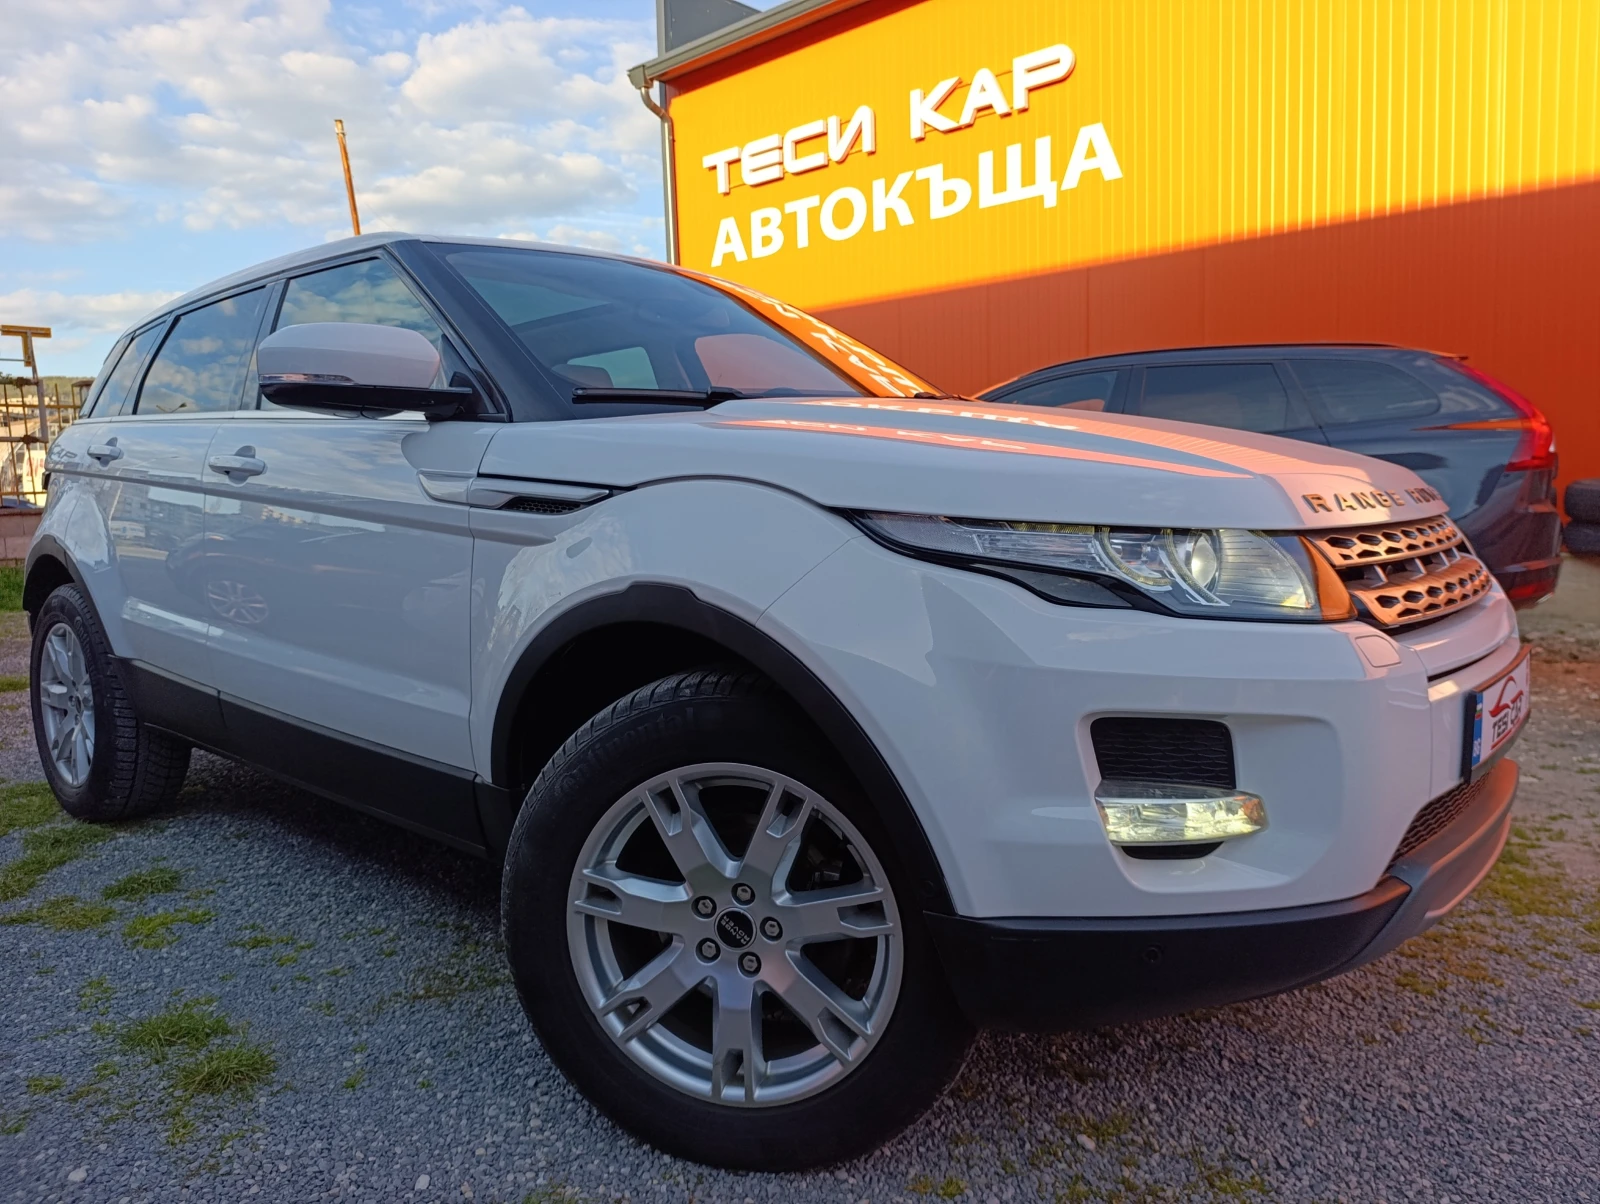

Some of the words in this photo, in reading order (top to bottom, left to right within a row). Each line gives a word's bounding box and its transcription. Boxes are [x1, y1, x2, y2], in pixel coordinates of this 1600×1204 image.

[702, 105, 876, 195] ТЕСИ
[909, 43, 1077, 141] КАР
[711, 122, 1124, 268] АВТОКЪЩА
[1301, 489, 1405, 513] RANGE
